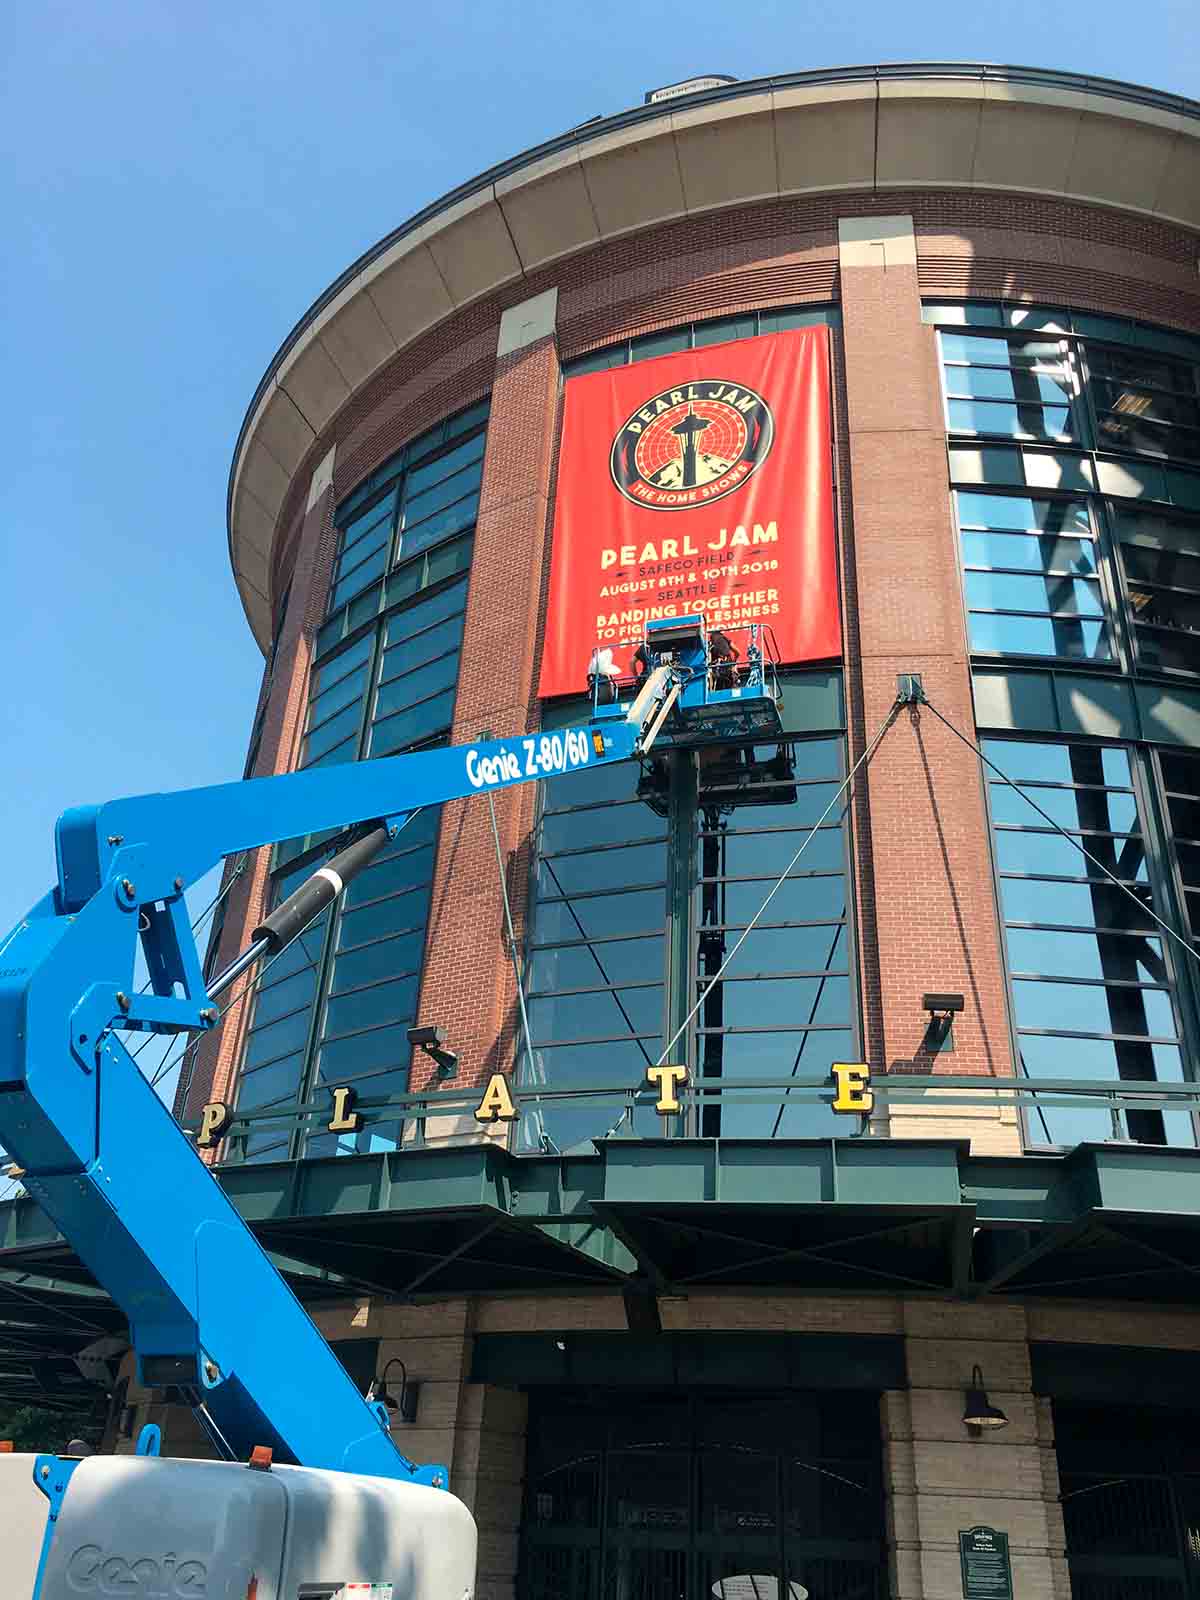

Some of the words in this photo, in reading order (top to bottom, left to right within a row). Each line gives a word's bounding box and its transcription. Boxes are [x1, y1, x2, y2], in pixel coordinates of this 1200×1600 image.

[627, 386, 699, 434] PEARL
[708, 384, 758, 413] JAM
[634, 484, 656, 500] THE
[657, 491, 697, 503] HOME
[702, 464, 748, 497] SHOWS
[600, 535, 699, 570] PEARL
[707, 521, 778, 550] JAM
[639, 559, 693, 576] SAFECO
[697, 551, 735, 567] FIELD
[600, 578, 656, 597] AUGUST
[687, 572, 697, 583] &
[702, 564, 738, 580] 10TH
[741, 559, 778, 575] 2018
[657, 583, 718, 601] SEATTLE
[596, 606, 677, 627] BANDING
[682, 588, 778, 614] TOGETHER
[596, 628, 615, 640] TO
[619, 624, 642, 637] FIG
[706, 603, 780, 622] LESSNESS
[466, 747, 522, 788] Genie
[523, 729, 589, 776] Z-80/60
[197, 1063, 873, 1145] PLATE
[66, 1543, 209, 1599] Genie
